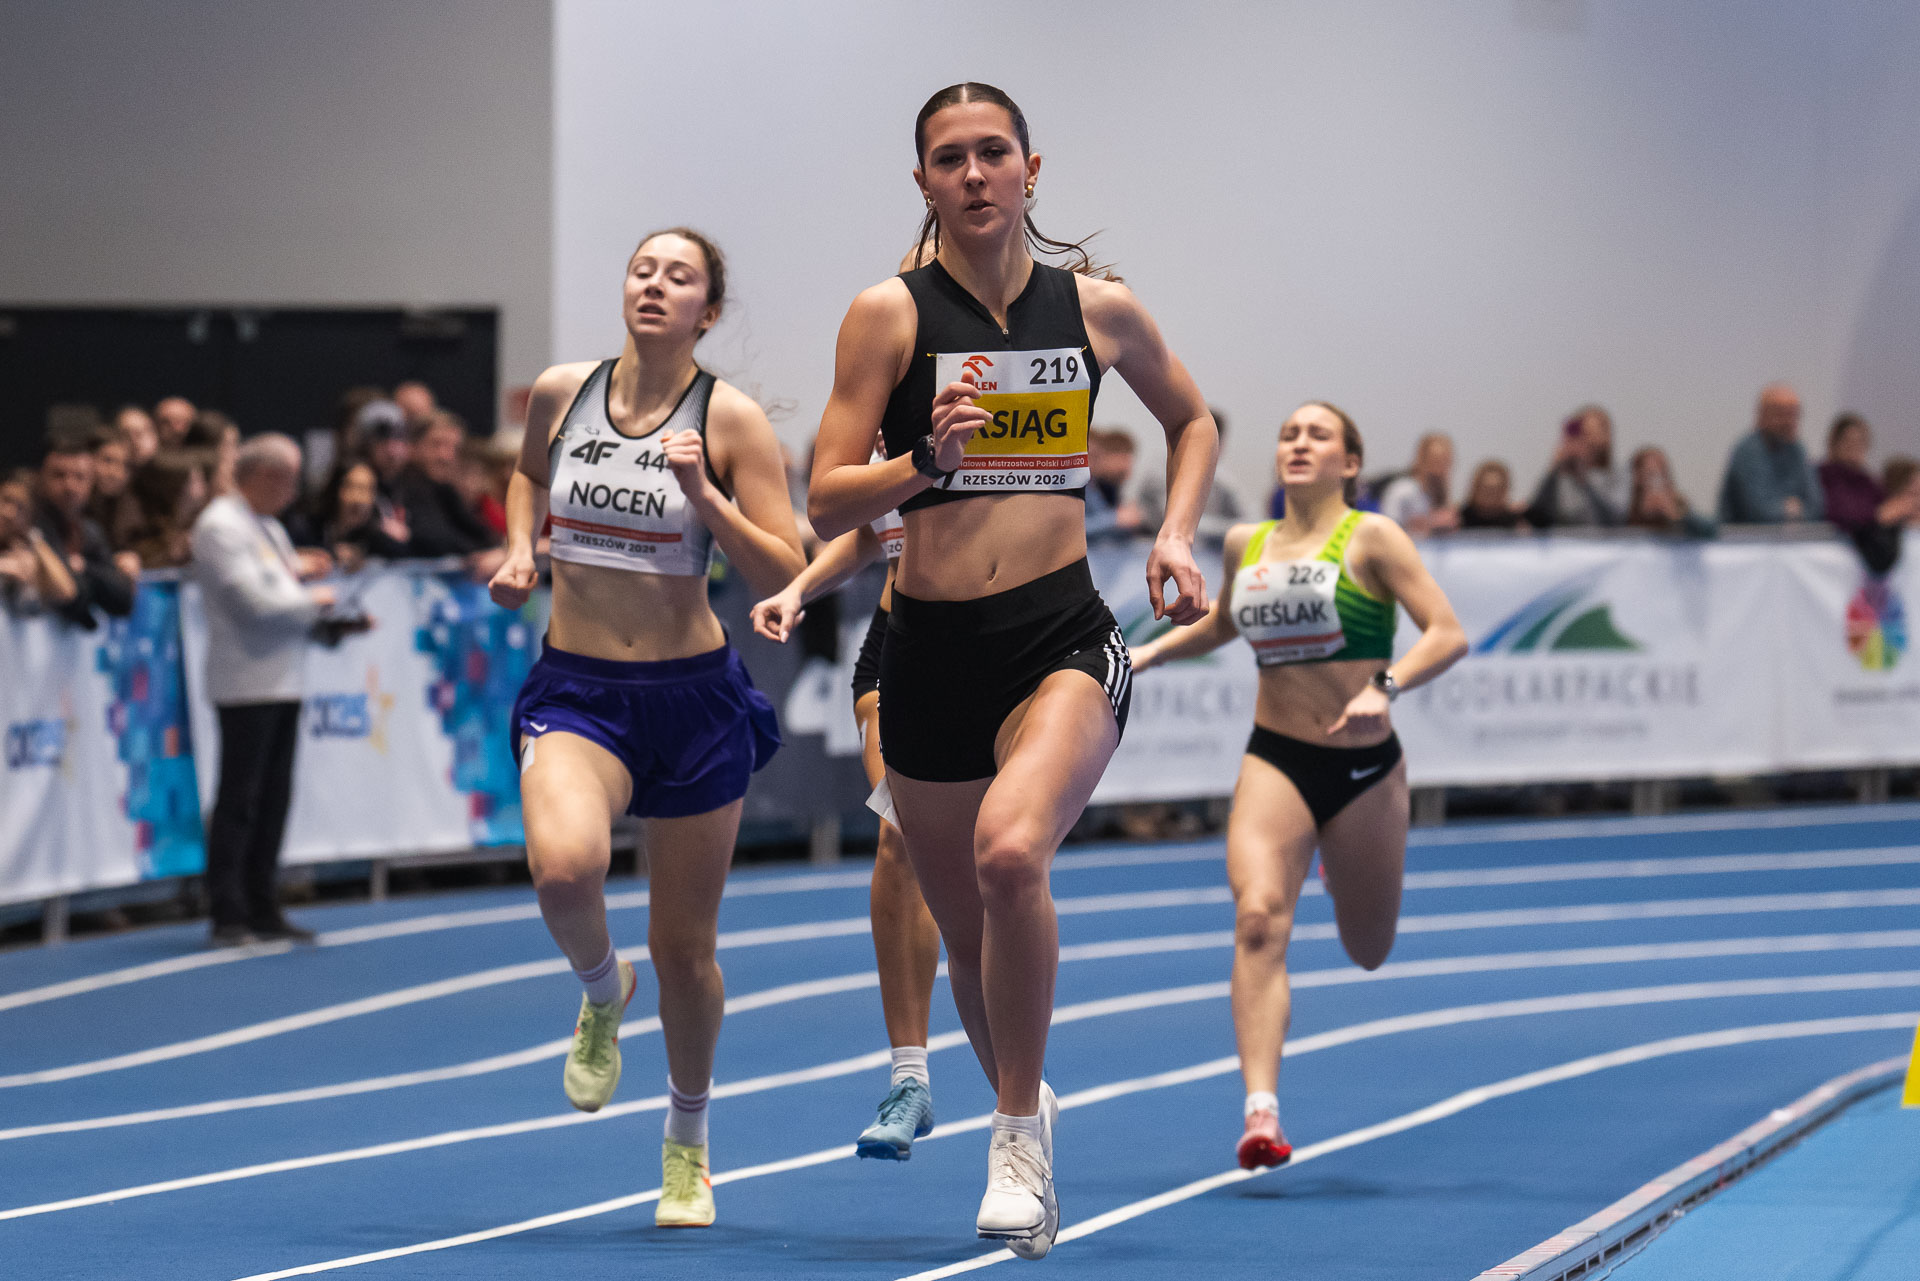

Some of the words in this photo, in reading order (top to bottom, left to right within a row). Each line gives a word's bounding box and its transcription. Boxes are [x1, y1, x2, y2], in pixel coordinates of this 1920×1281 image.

[1029, 356, 1079, 385] 219
[569, 439, 621, 466] 4F
[634, 449, 672, 473] 44
[988, 459, 1035, 468] Mistrzostwa
[1036, 459, 1059, 468] Polski
[962, 471, 1031, 486] RZESZÓW
[1034, 473, 1066, 486] 2026
[568, 481, 667, 518] NOCEŃ
[572, 533, 626, 551] RZESZÓW
[1288, 566, 1326, 585] 226
[1239, 597, 1328, 628] CIEŚLAK
